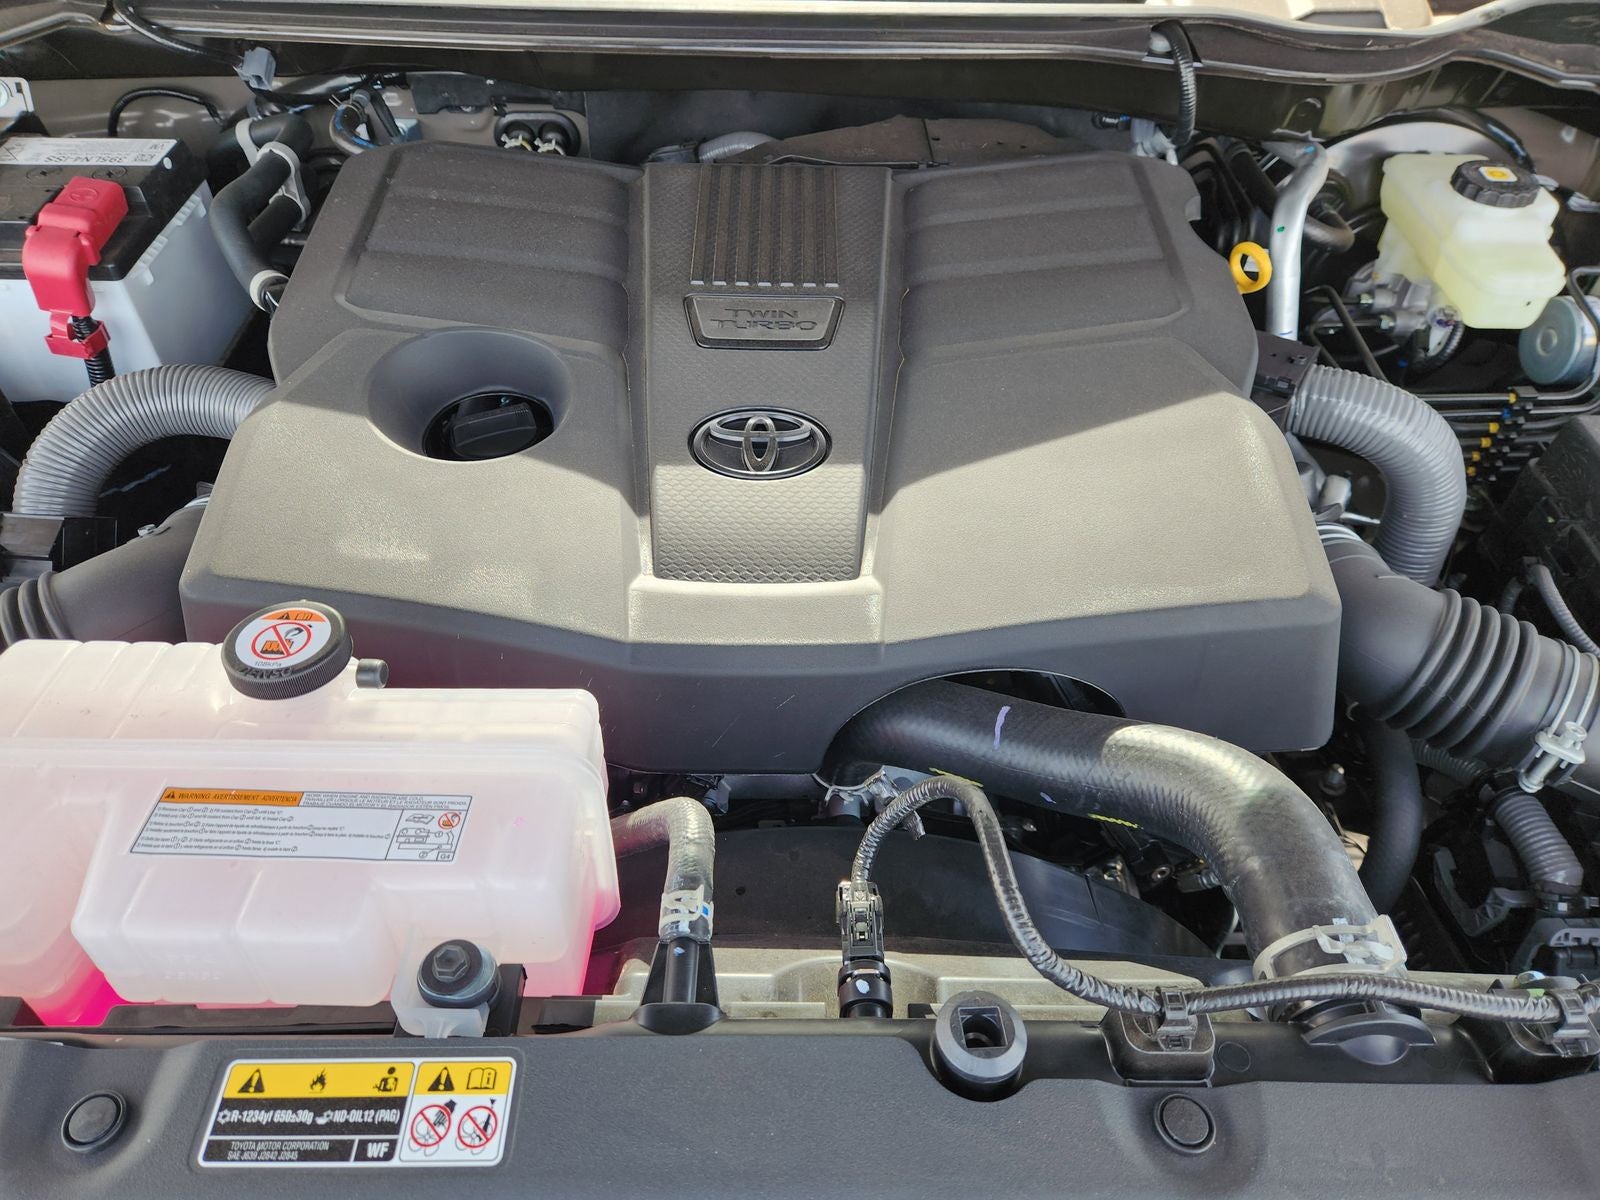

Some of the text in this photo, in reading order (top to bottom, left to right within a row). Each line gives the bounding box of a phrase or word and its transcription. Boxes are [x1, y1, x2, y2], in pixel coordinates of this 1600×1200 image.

[724, 308, 798, 318] TWIN
[710, 318, 817, 330] TURBO
[230, 1110, 271, 1125] R-1234yf
[374, 1109, 400, 1124] (PAG)
[231, 1141, 329, 1150] TOYOTA MOTOR CORPORATION
[366, 1142, 389, 1158] WF
[227, 1152, 240, 1161] SAE
